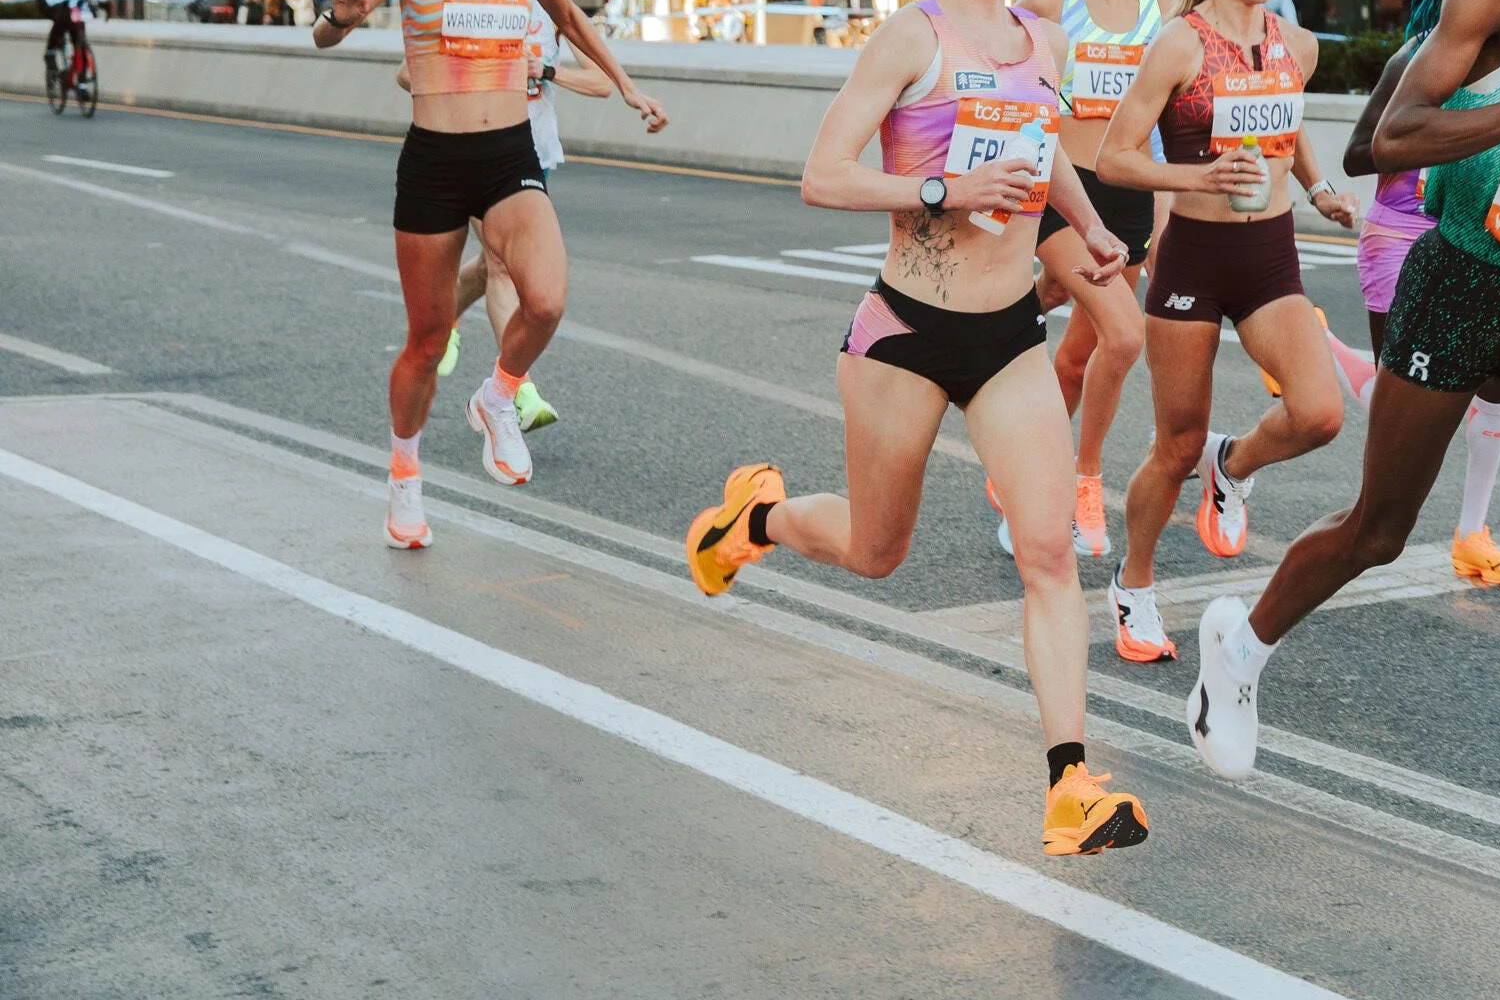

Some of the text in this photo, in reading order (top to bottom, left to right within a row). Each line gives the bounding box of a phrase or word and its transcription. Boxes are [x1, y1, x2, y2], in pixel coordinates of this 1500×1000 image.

[446, 11, 526, 31] WARNER-JUDD
[1089, 69, 1135, 96] VEST
[1225, 73, 1247, 92] tcs
[974, 101, 1002, 122] tcs
[1229, 101, 1294, 132] SISSON
[967, 136, 1046, 177] FRIE
